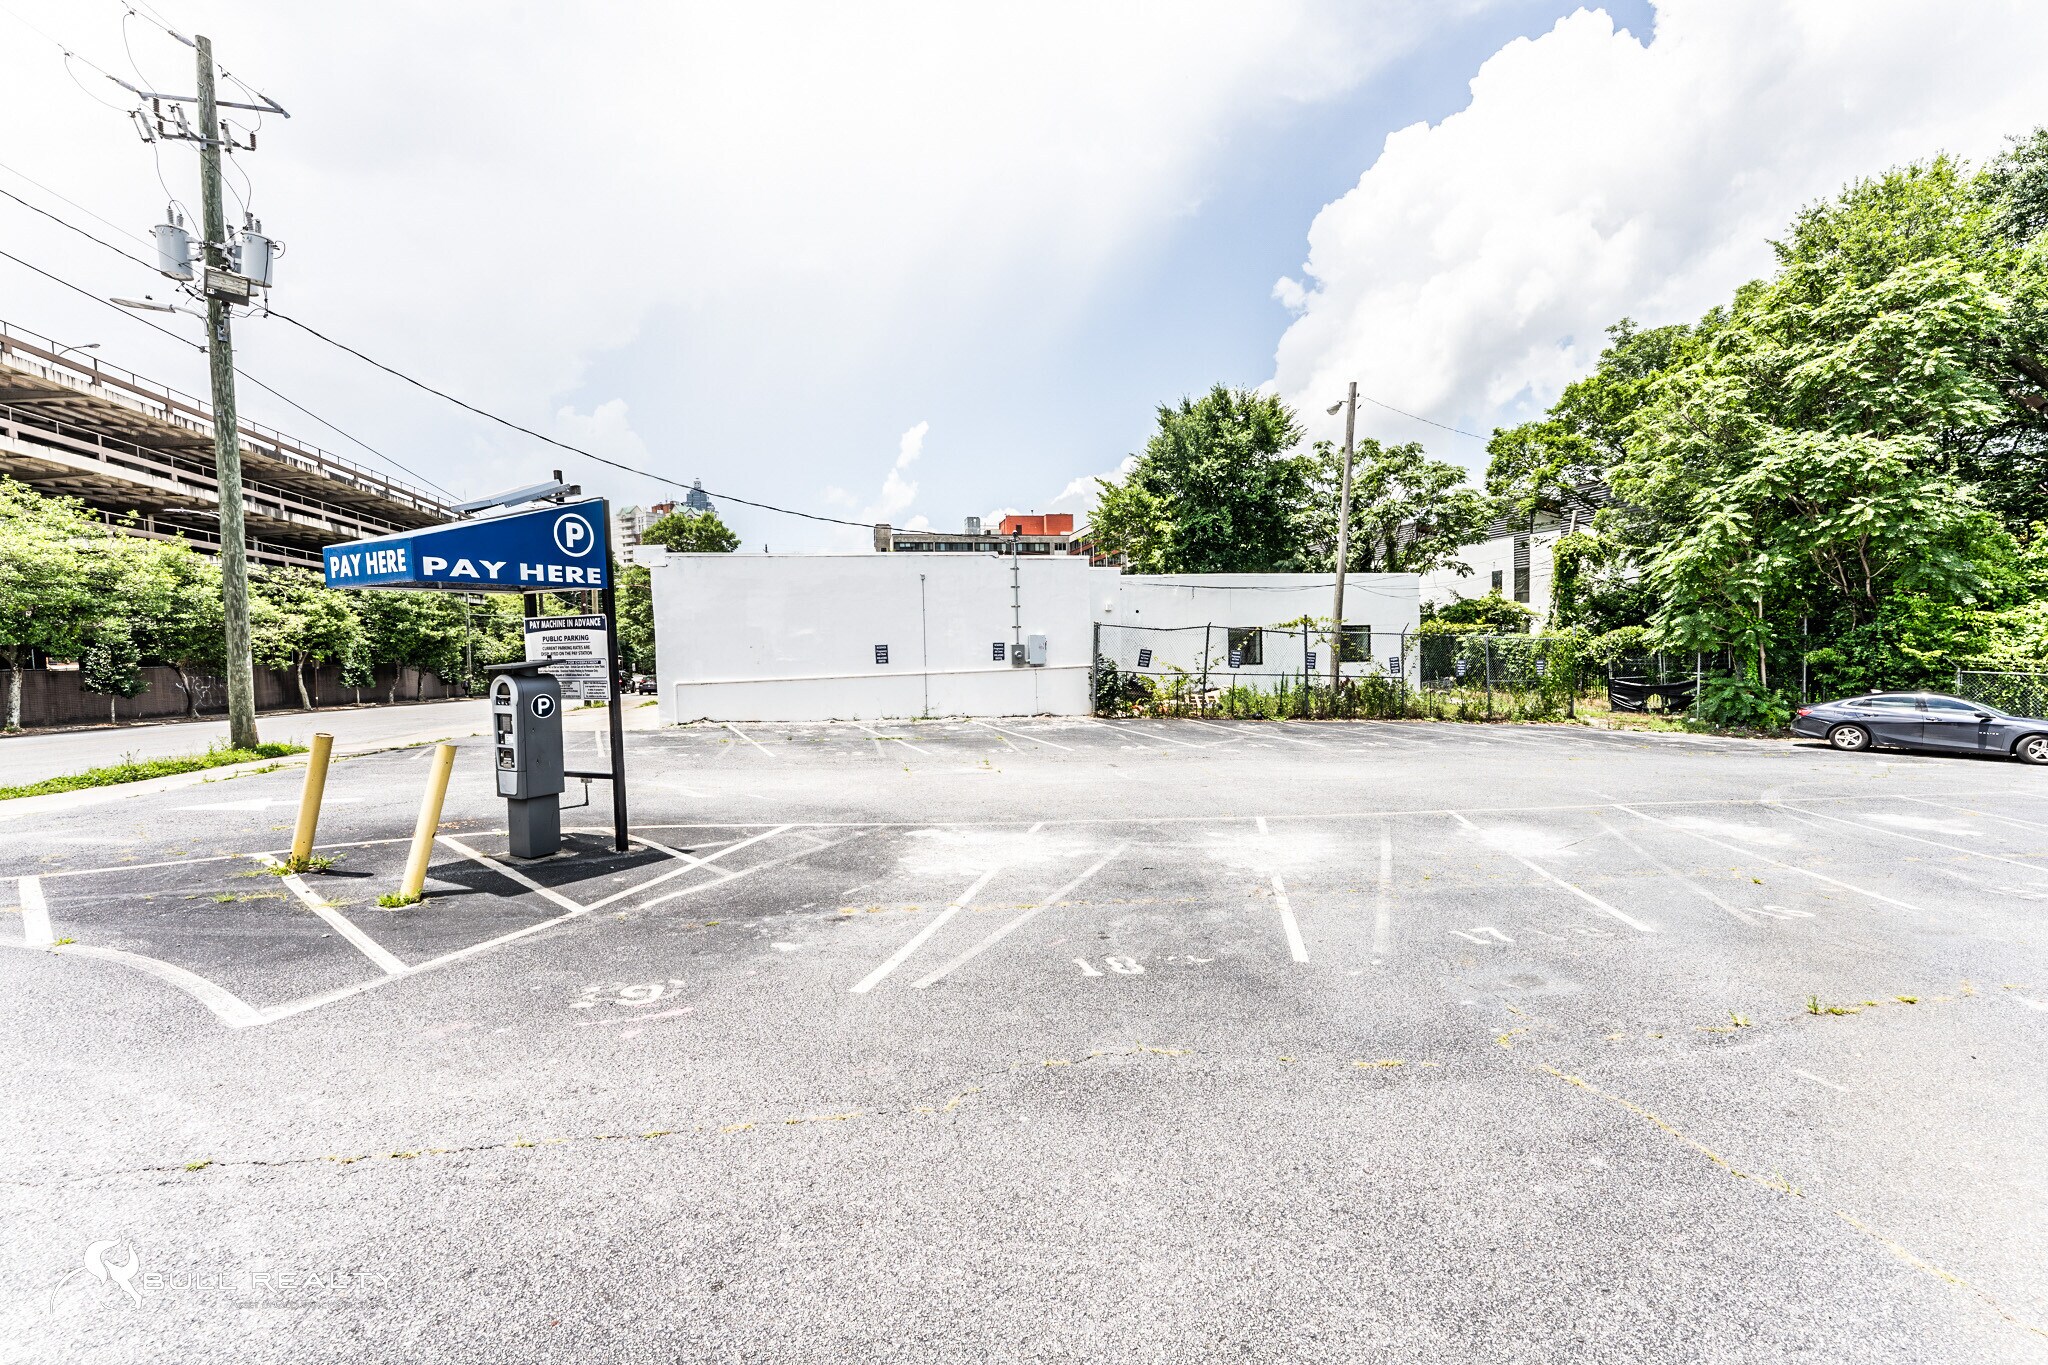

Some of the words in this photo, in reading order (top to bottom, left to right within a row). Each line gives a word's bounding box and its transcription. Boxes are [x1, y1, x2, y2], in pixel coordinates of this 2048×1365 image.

[566, 522, 584, 548] P
[329, 552, 361, 579] PAY
[365, 548, 407, 574] HERE
[422, 556, 507, 579] PAY
[520, 562, 602, 585] HERE
[529, 620, 540, 629] PAY
[541, 619, 566, 629] MACHINE
[566, 619, 574, 628] IN
[574, 617, 601, 627] ADVANCE
[537, 698, 550, 715] P
[1072, 956, 1145, 976] 18
